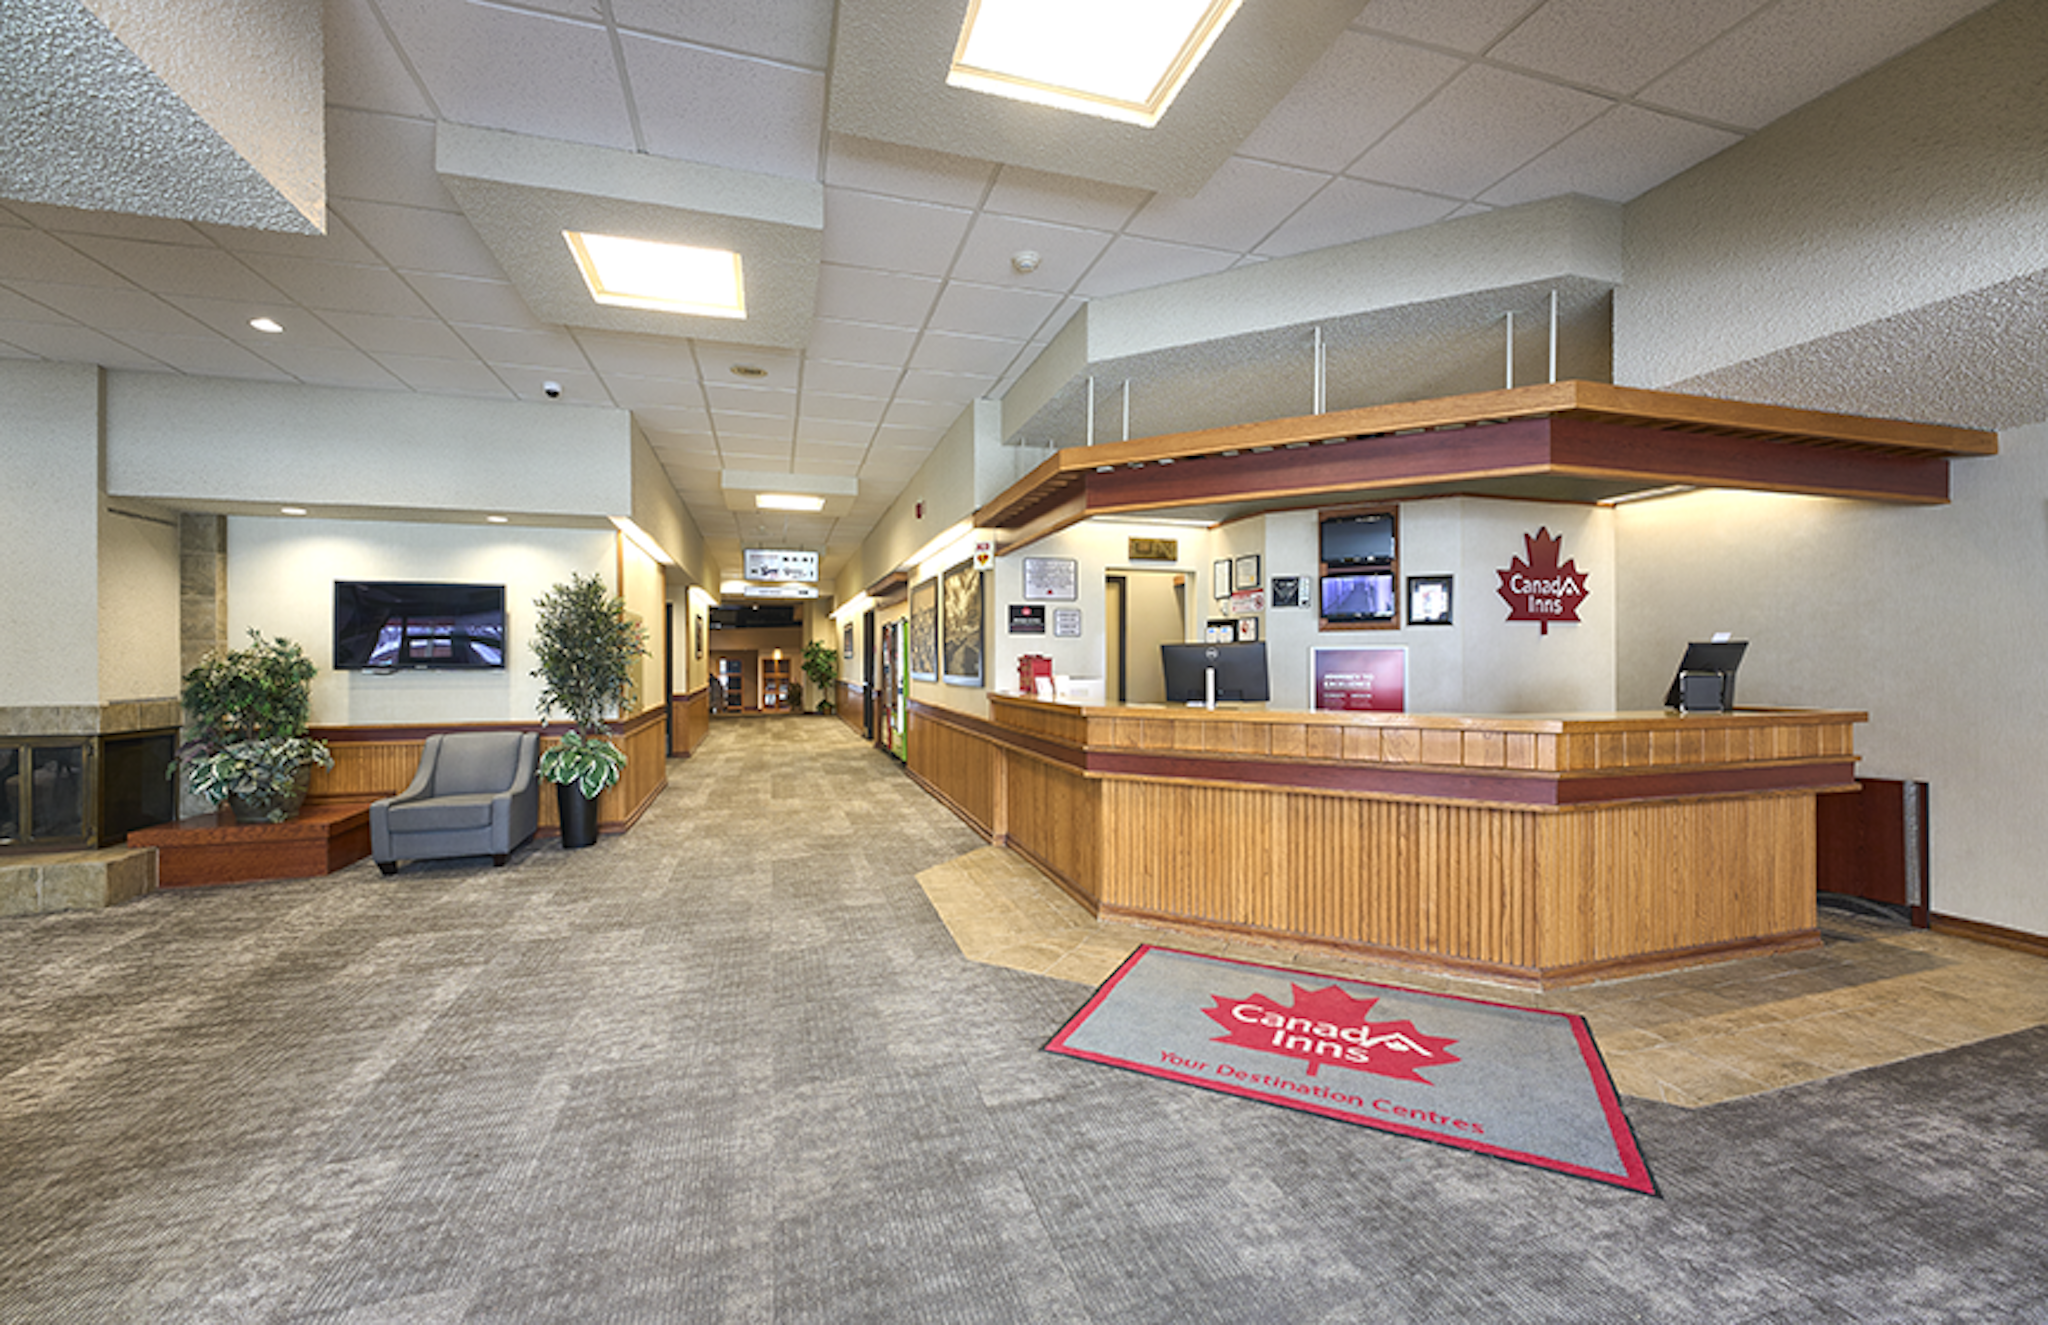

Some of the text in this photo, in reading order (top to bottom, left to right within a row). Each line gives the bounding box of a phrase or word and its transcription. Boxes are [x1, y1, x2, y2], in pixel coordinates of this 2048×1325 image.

[1527, 594, 1564, 615] Inns
[1267, 1029, 1370, 1063] Inns
[1159, 1050, 1486, 1135] Your Destination Centres
